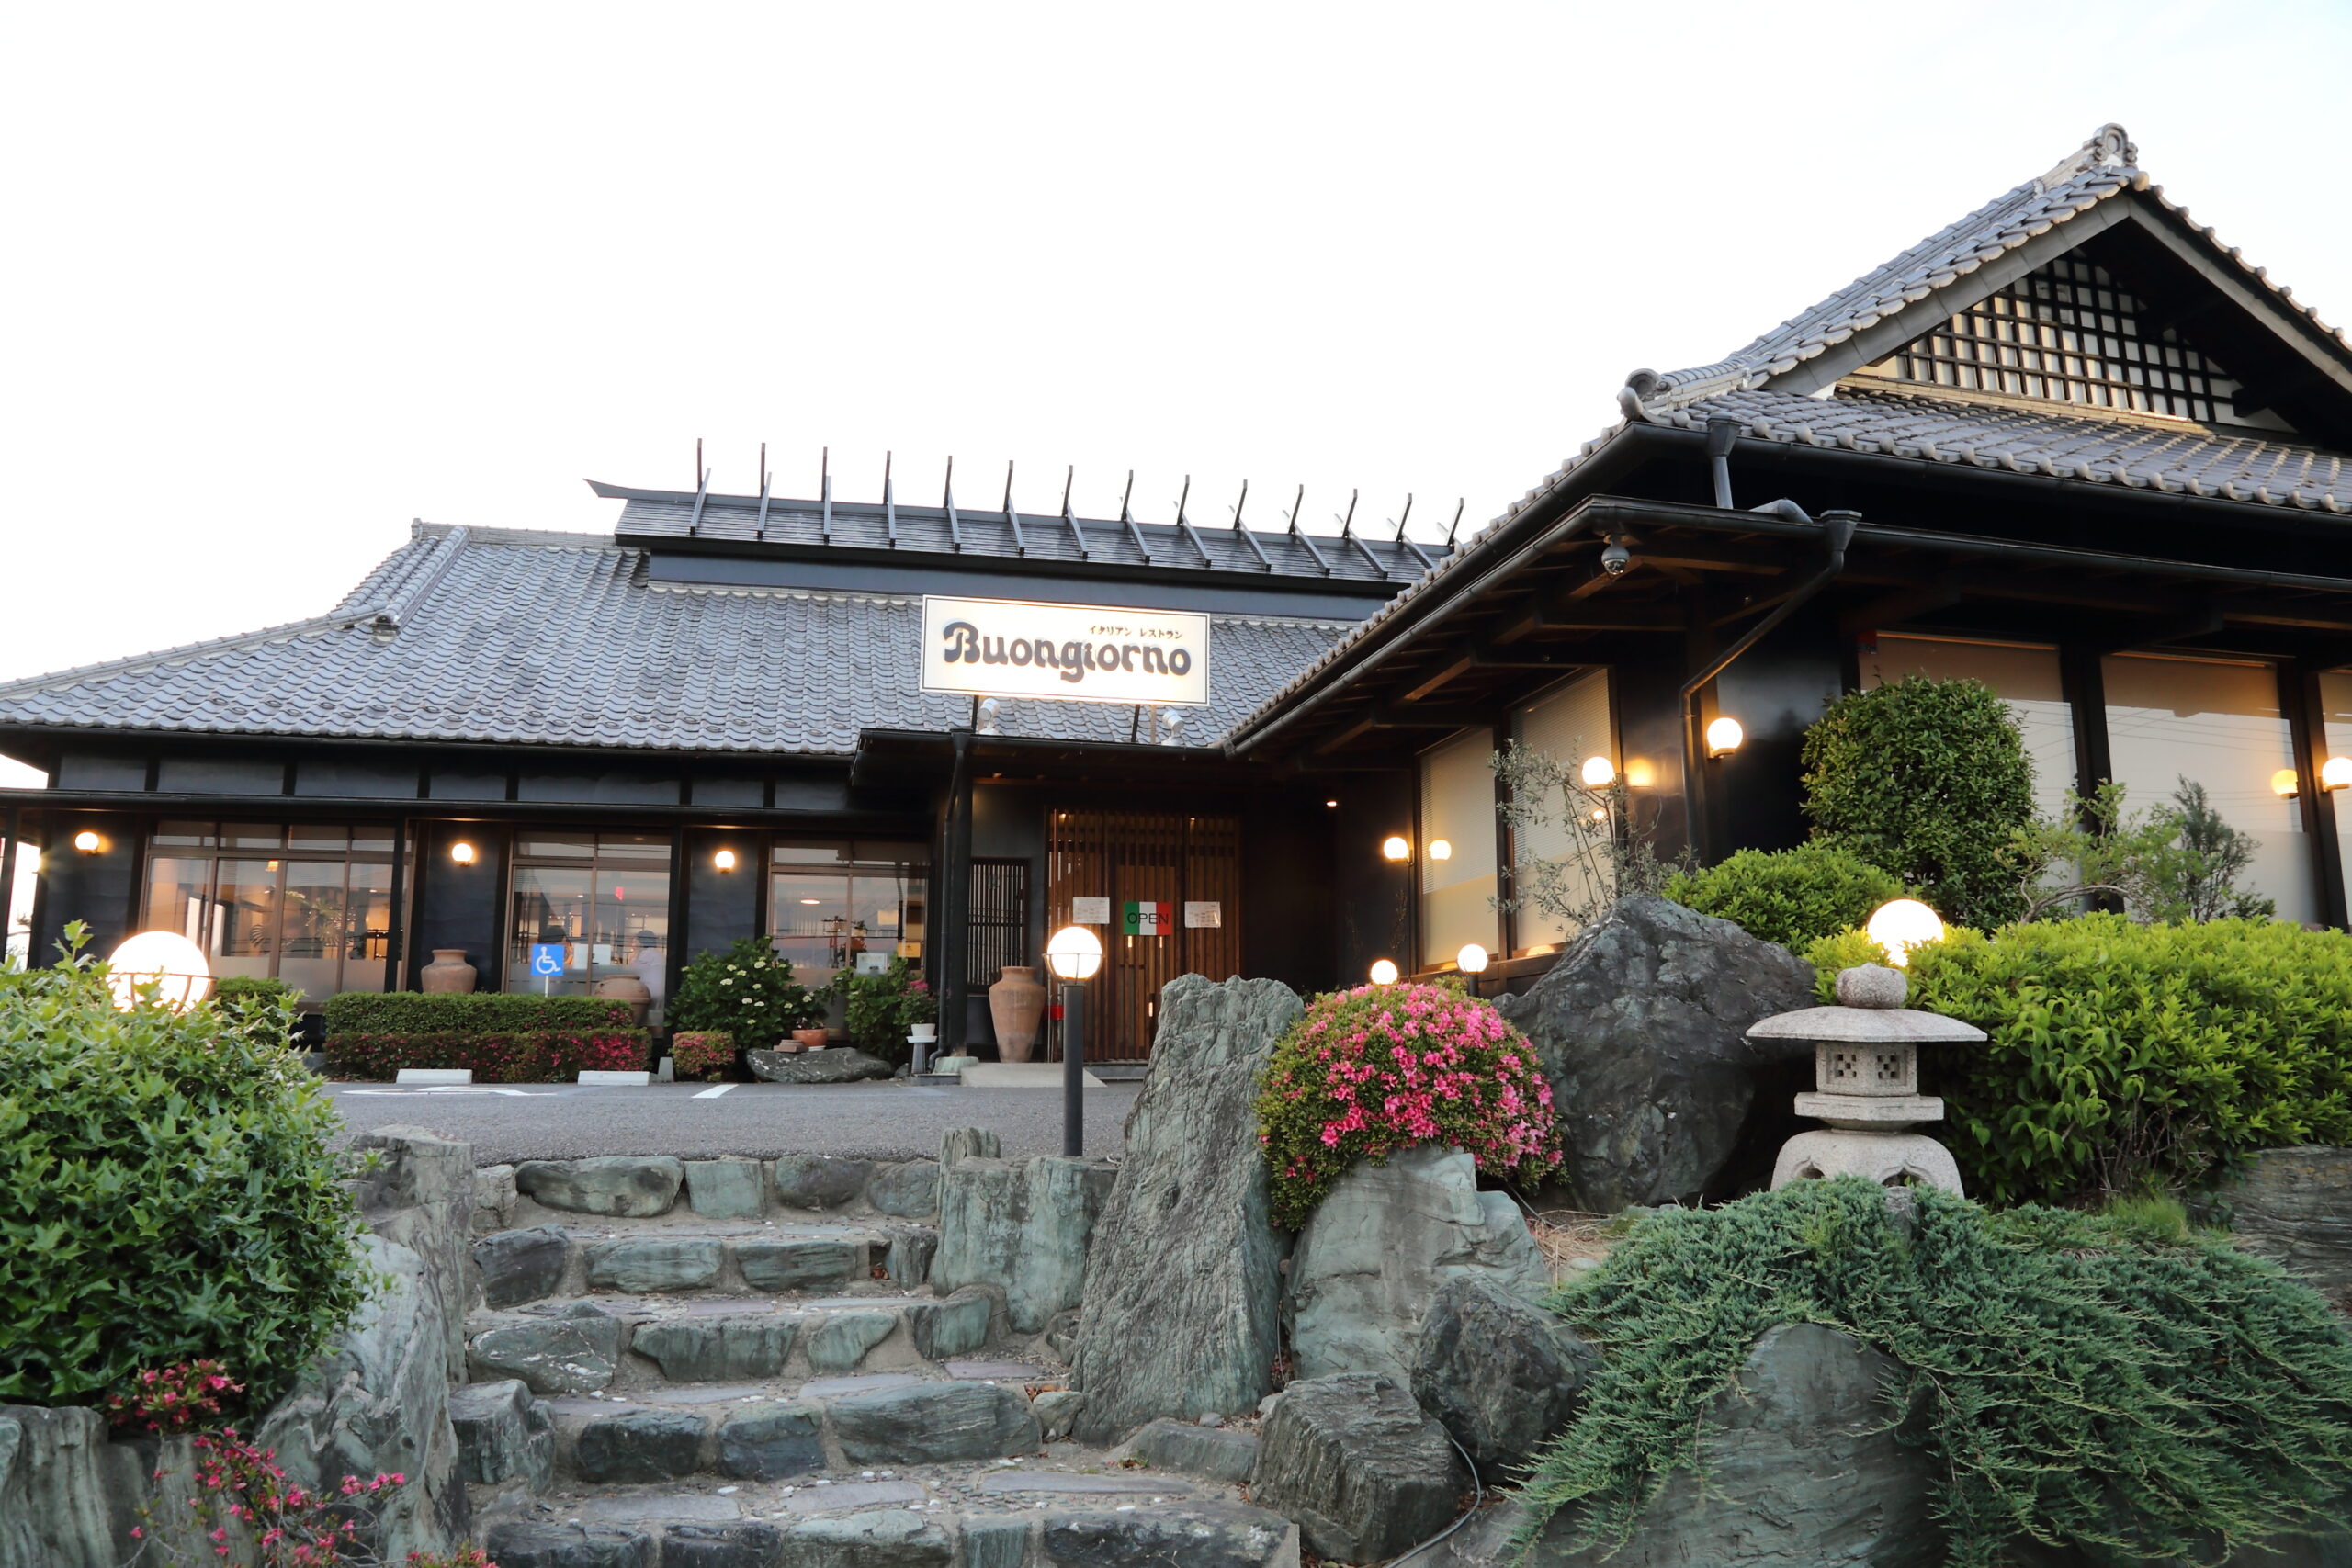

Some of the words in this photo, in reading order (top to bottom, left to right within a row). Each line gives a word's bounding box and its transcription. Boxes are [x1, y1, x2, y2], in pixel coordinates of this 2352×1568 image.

[1090, 626, 1132, 637] イタリアン
[1139, 627, 1183, 640] レストラン
[944, 622, 1191, 683] Buongiorno
[1127, 912, 1170, 925] OPEN
